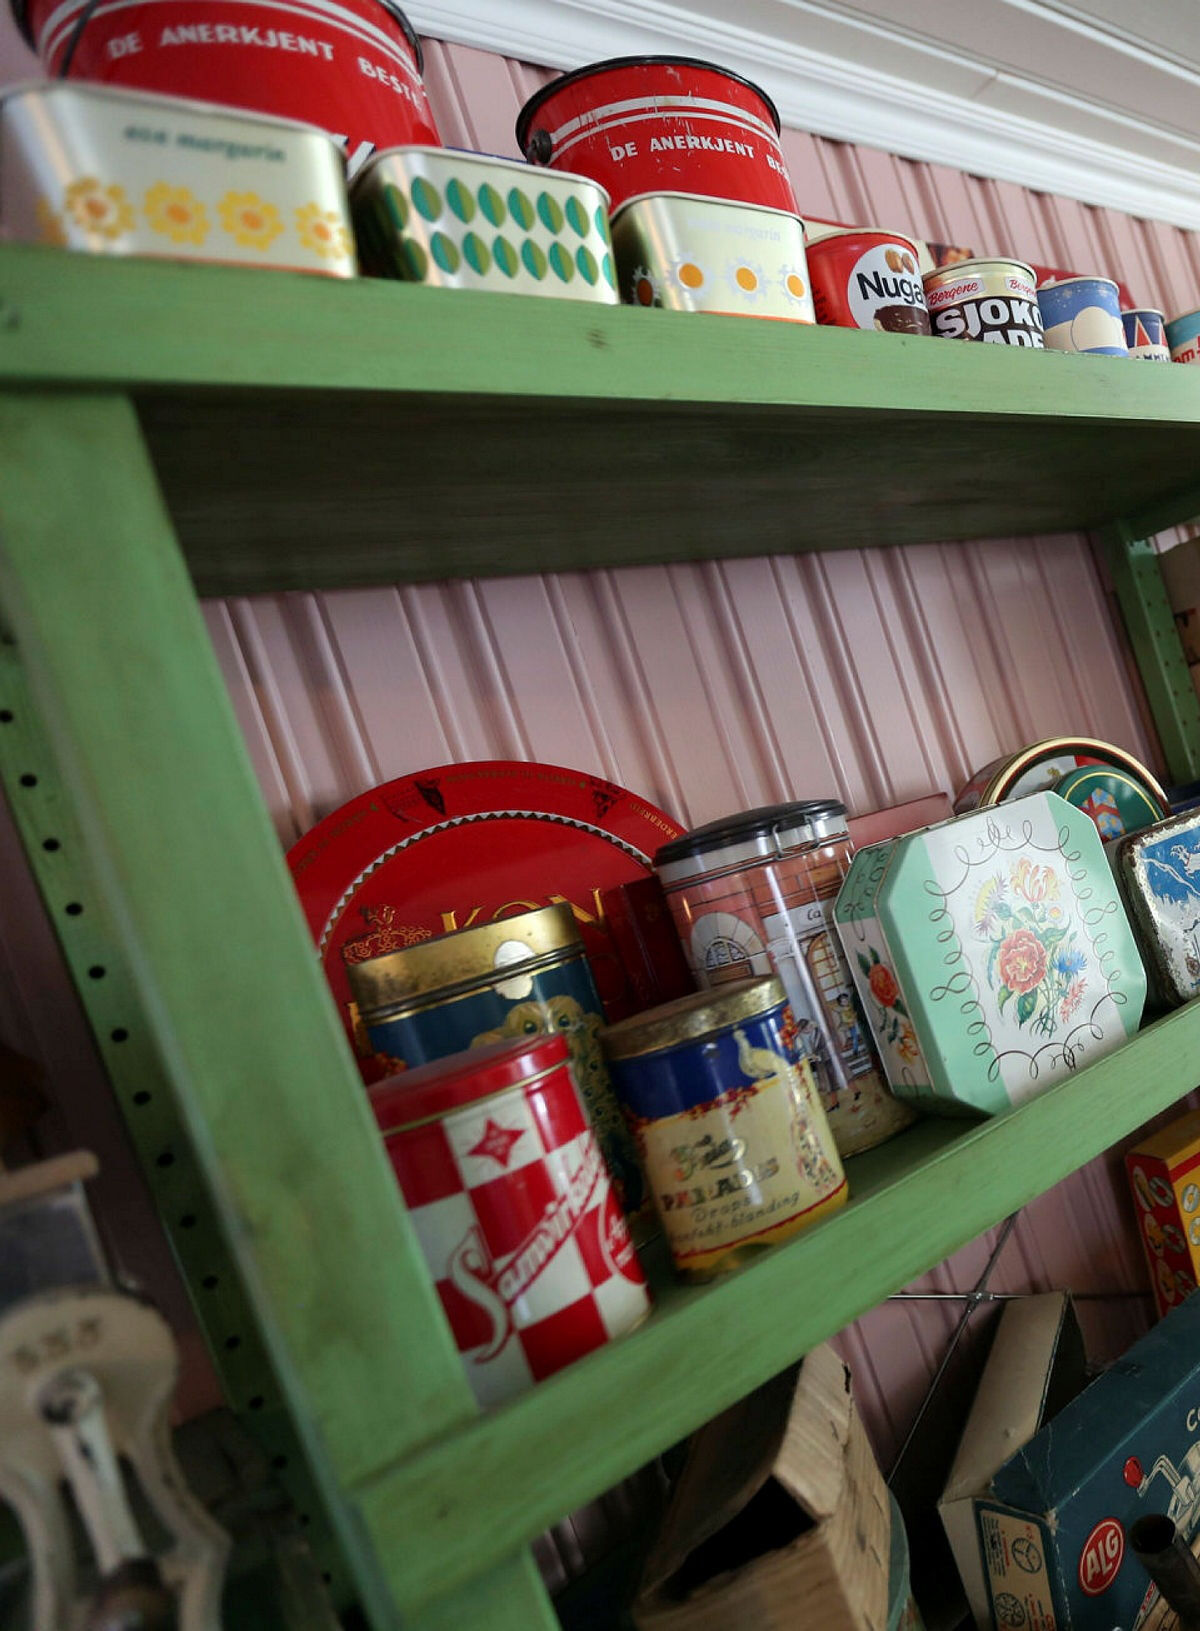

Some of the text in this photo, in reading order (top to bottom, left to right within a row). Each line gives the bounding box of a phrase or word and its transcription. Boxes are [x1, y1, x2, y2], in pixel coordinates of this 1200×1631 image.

[108, 31, 144, 60] DE
[159, 23, 335, 61] ANERKJENT
[610, 141, 639, 163] DE
[650, 135, 755, 160] ANERKJENT
[928, 281, 979, 306] Bergene
[1084, 1528, 1122, 1585] ALG
